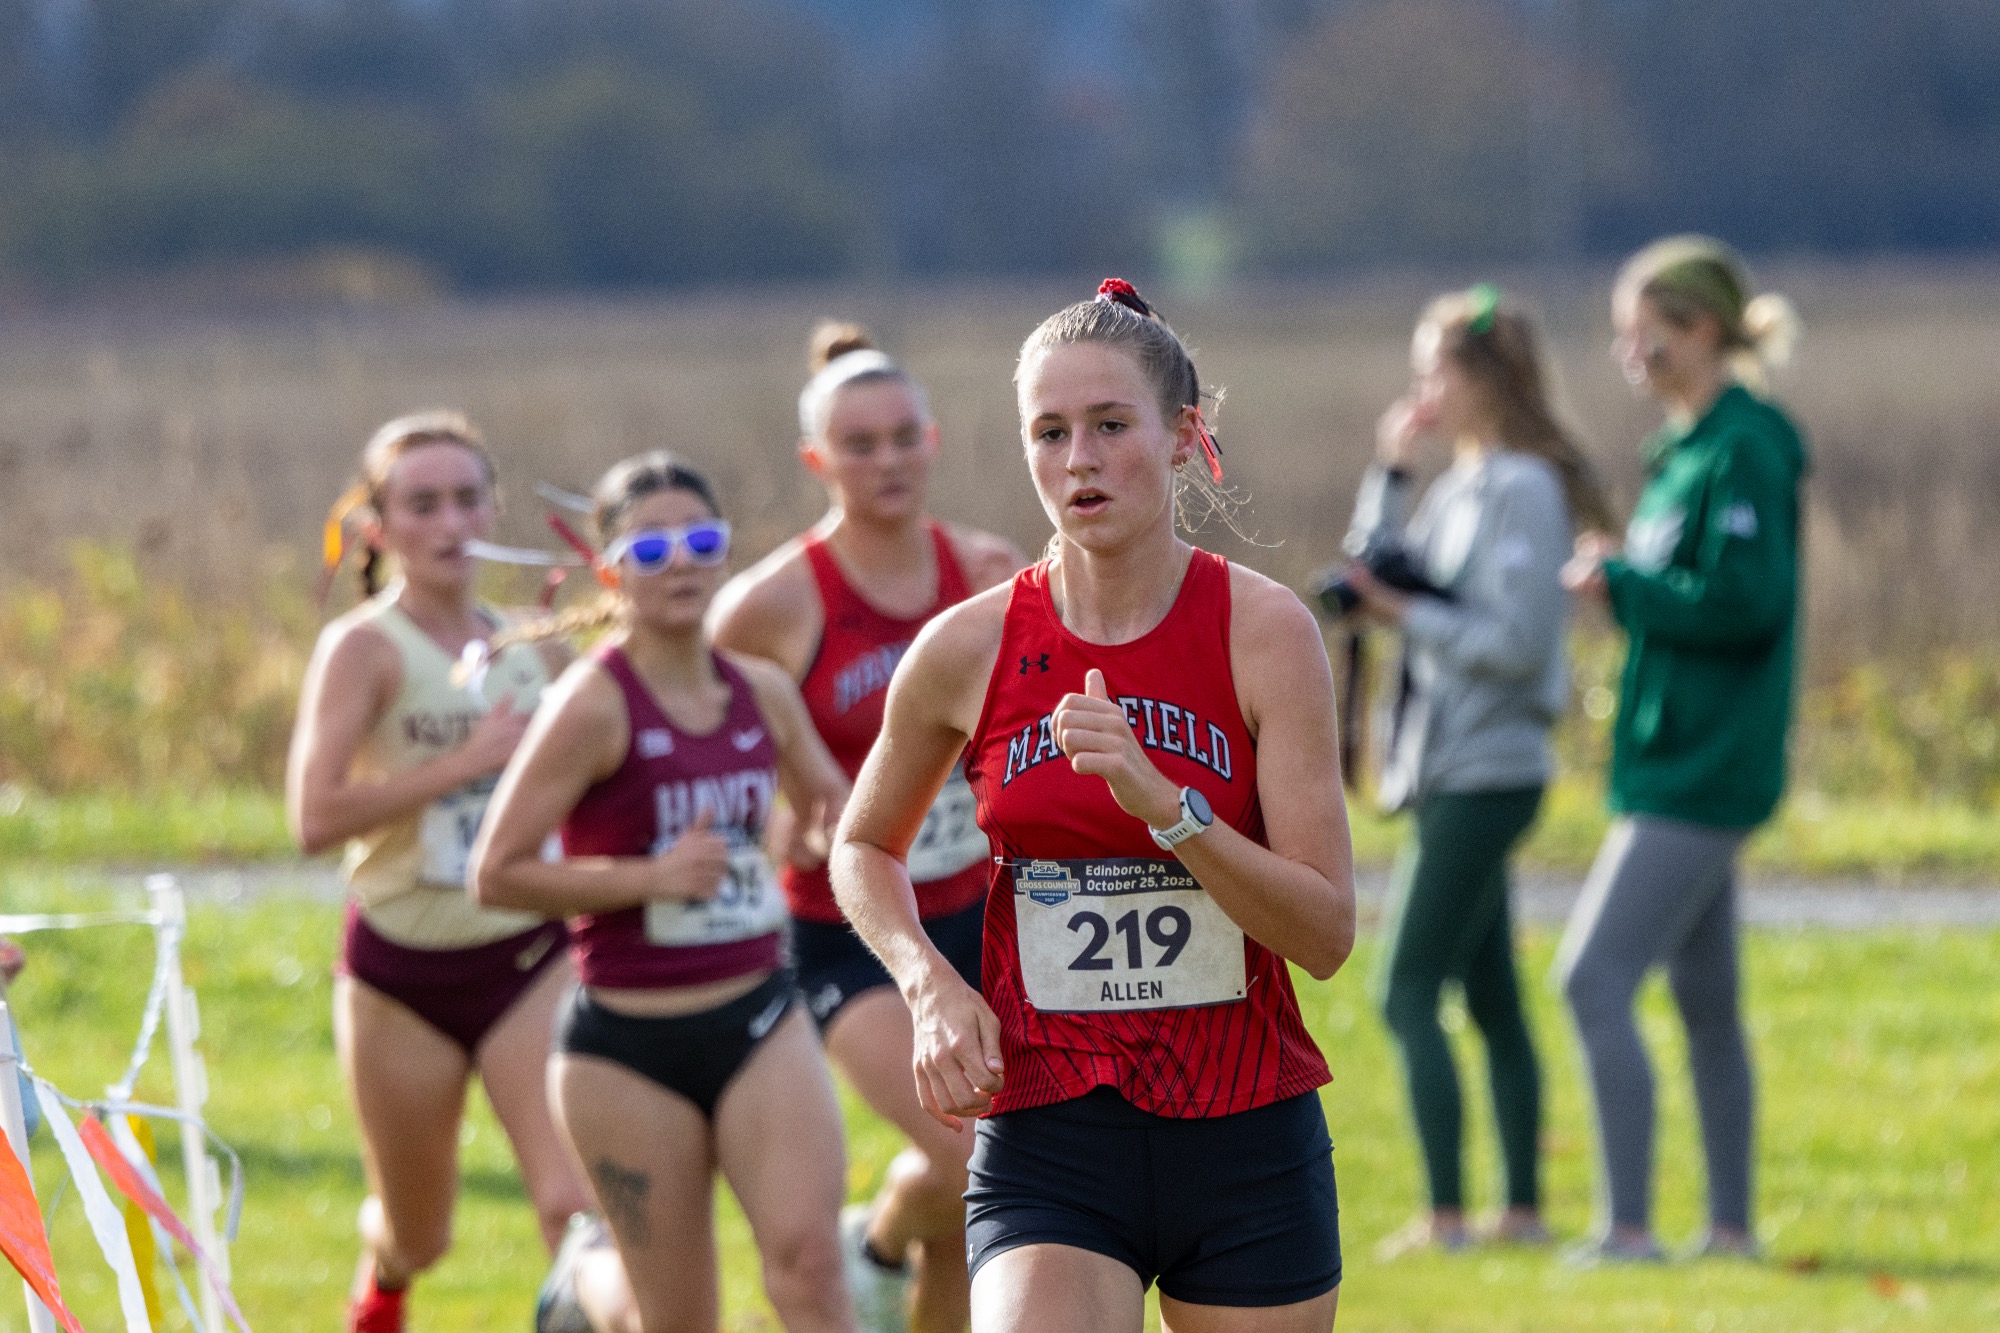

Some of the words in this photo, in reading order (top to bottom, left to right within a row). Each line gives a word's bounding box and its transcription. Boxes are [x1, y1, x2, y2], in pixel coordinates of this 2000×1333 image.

[1002, 695, 1233, 789] MAFIELD
[1033, 865, 1058, 873] PSAC
[1085, 864, 1145, 877] Edinboro,
[1148, 863, 1166, 874] PA
[1019, 881, 1043, 889] CROSS
[1043, 881, 1078, 890] COUNTRY
[1086, 879, 1137, 891] October
[1139, 877, 1159, 888] 25,
[1161, 876, 1194, 886] 2025
[1066, 904, 1192, 971] 219
[1100, 980, 1163, 1002] ALLEN
